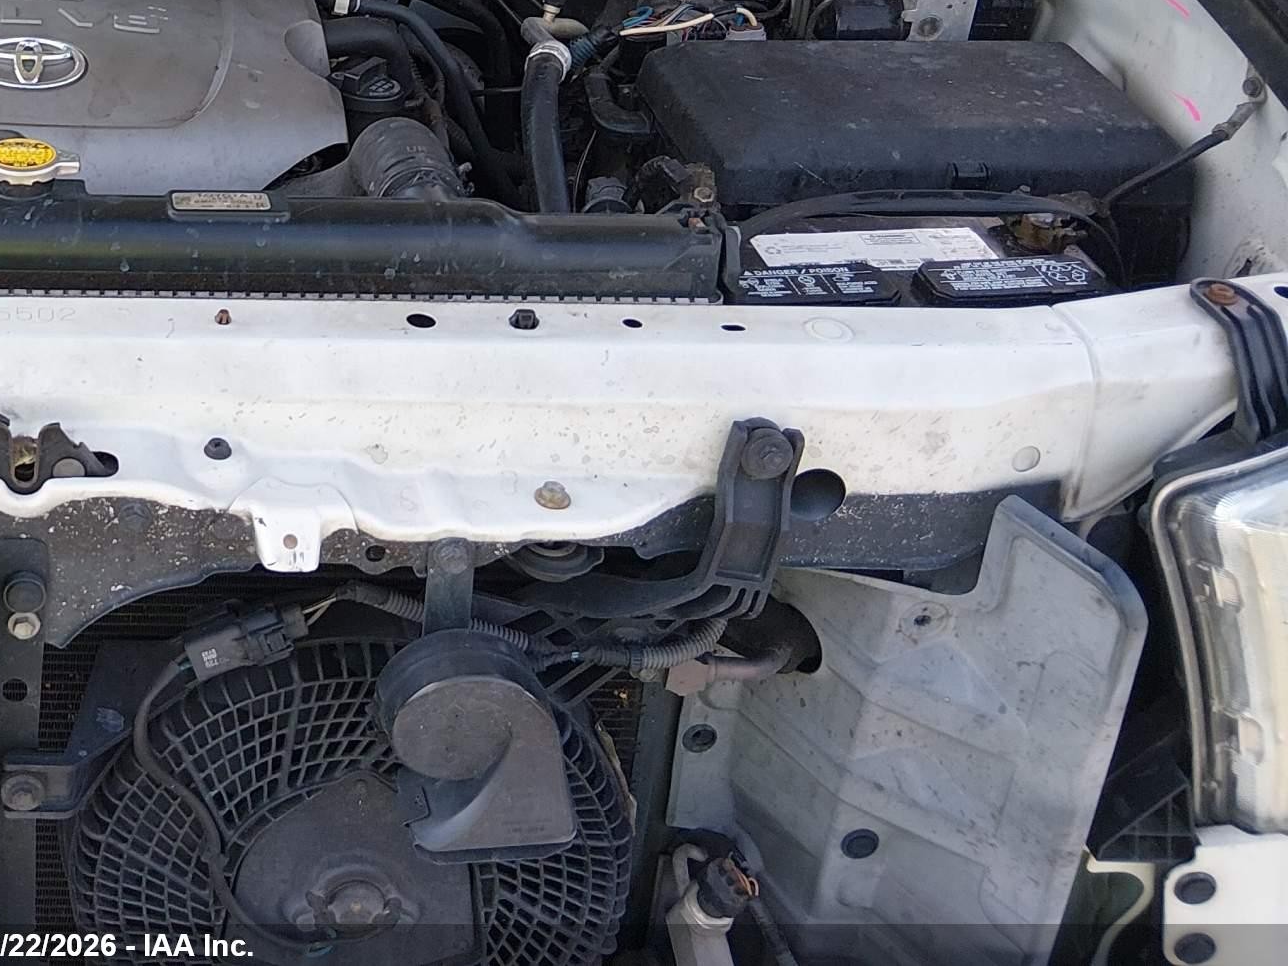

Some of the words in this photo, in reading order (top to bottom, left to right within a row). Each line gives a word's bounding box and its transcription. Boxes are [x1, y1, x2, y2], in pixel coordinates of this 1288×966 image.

[58, 6, 169, 33] V8
[754, 268, 799, 276] DANGER
[808, 266, 850, 274] POISON
